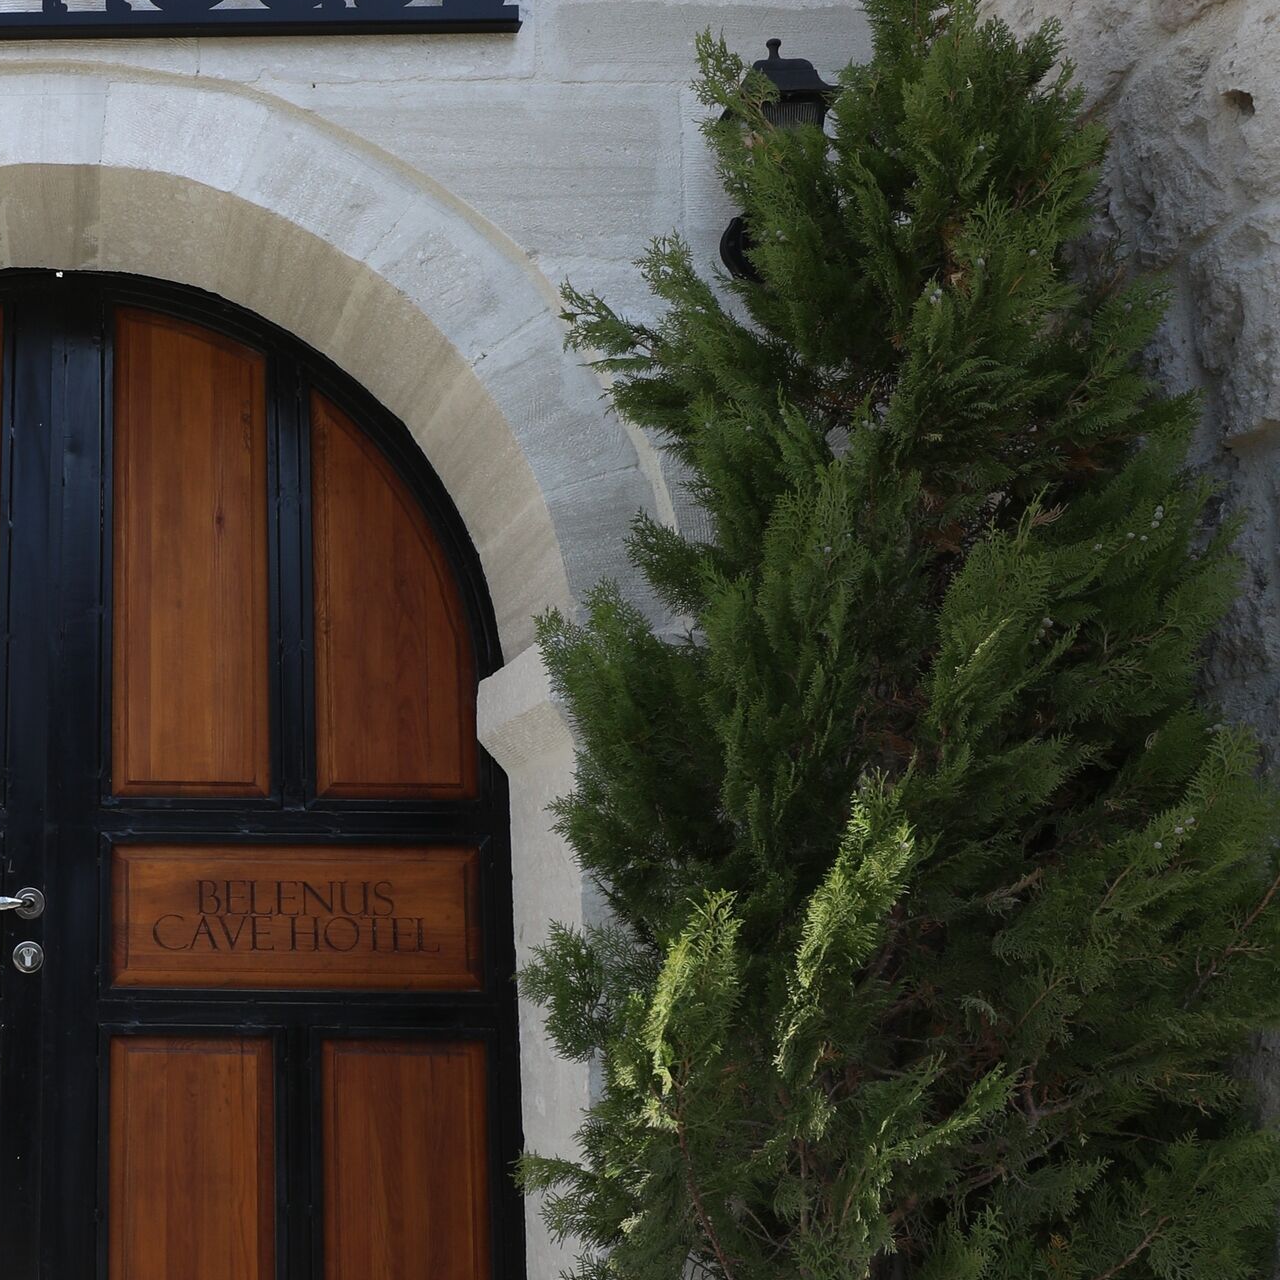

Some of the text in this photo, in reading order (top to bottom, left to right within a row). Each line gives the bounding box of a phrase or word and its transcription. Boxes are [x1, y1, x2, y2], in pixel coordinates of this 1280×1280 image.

[195, 879, 395, 916] BELENUS
[151, 914, 440, 953] CAVE HOTEL
